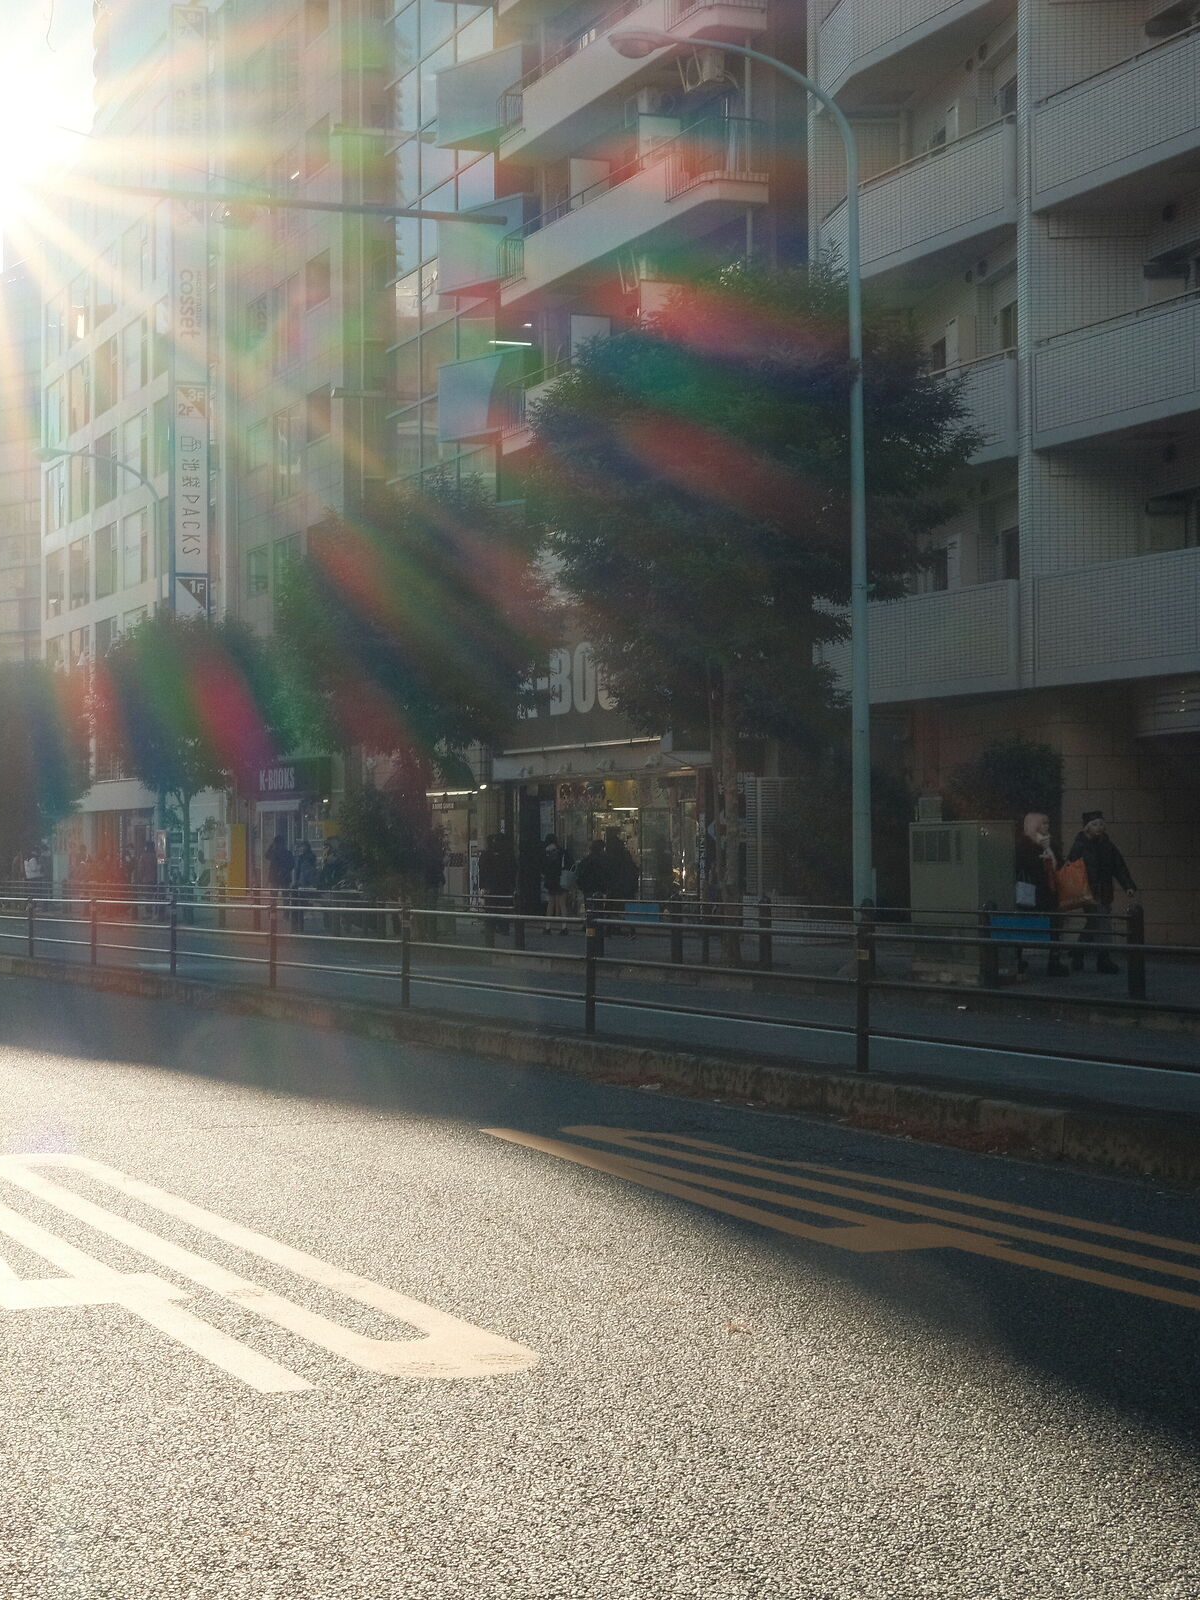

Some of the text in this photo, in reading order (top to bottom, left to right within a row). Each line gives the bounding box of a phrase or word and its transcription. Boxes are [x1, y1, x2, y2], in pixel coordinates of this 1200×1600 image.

[179, 269, 200, 338] cosset
[189, 389, 204, 402] 3F
[178, 403, 194, 416] 2F
[190, 580, 205, 594] 1F
[259, 767, 295, 791] K-BOOKS
